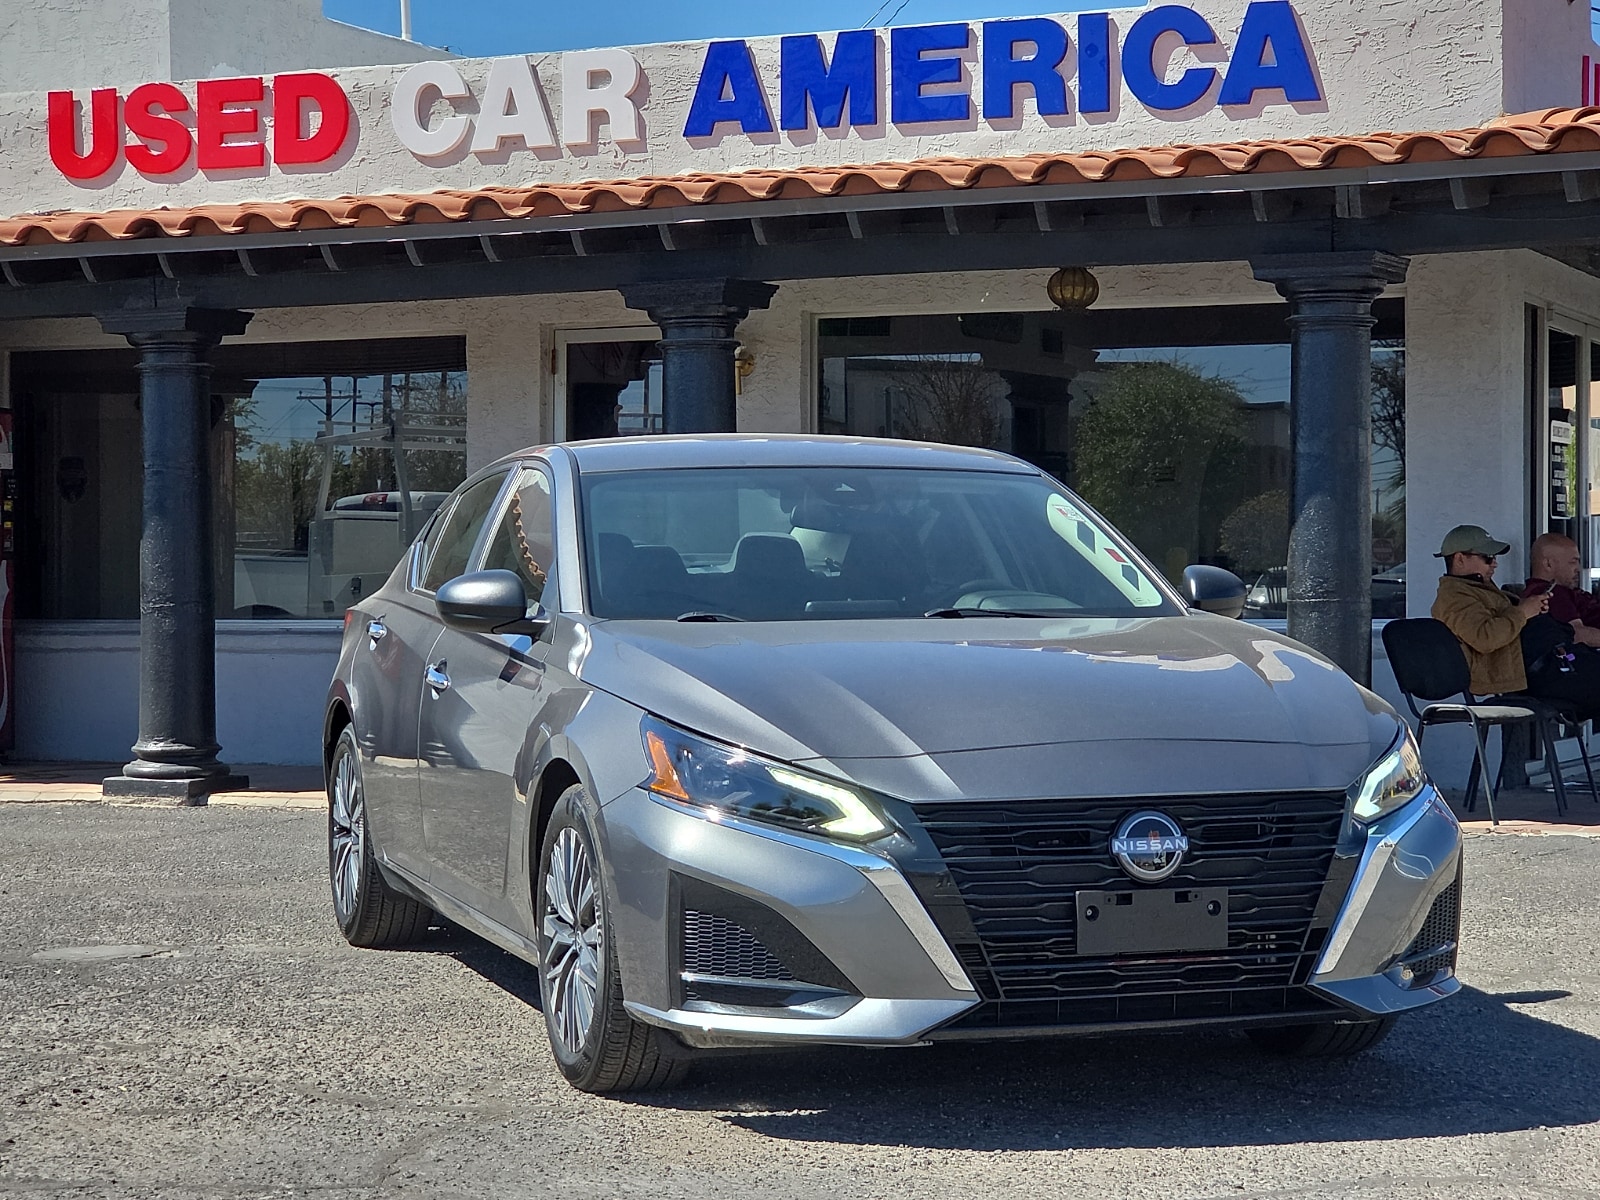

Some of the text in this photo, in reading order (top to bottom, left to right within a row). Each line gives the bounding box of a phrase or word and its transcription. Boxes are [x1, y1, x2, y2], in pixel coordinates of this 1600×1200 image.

[48, 0, 1321, 179] USED CAR AMERICA
[1114, 839, 1187, 851] NISSAN
